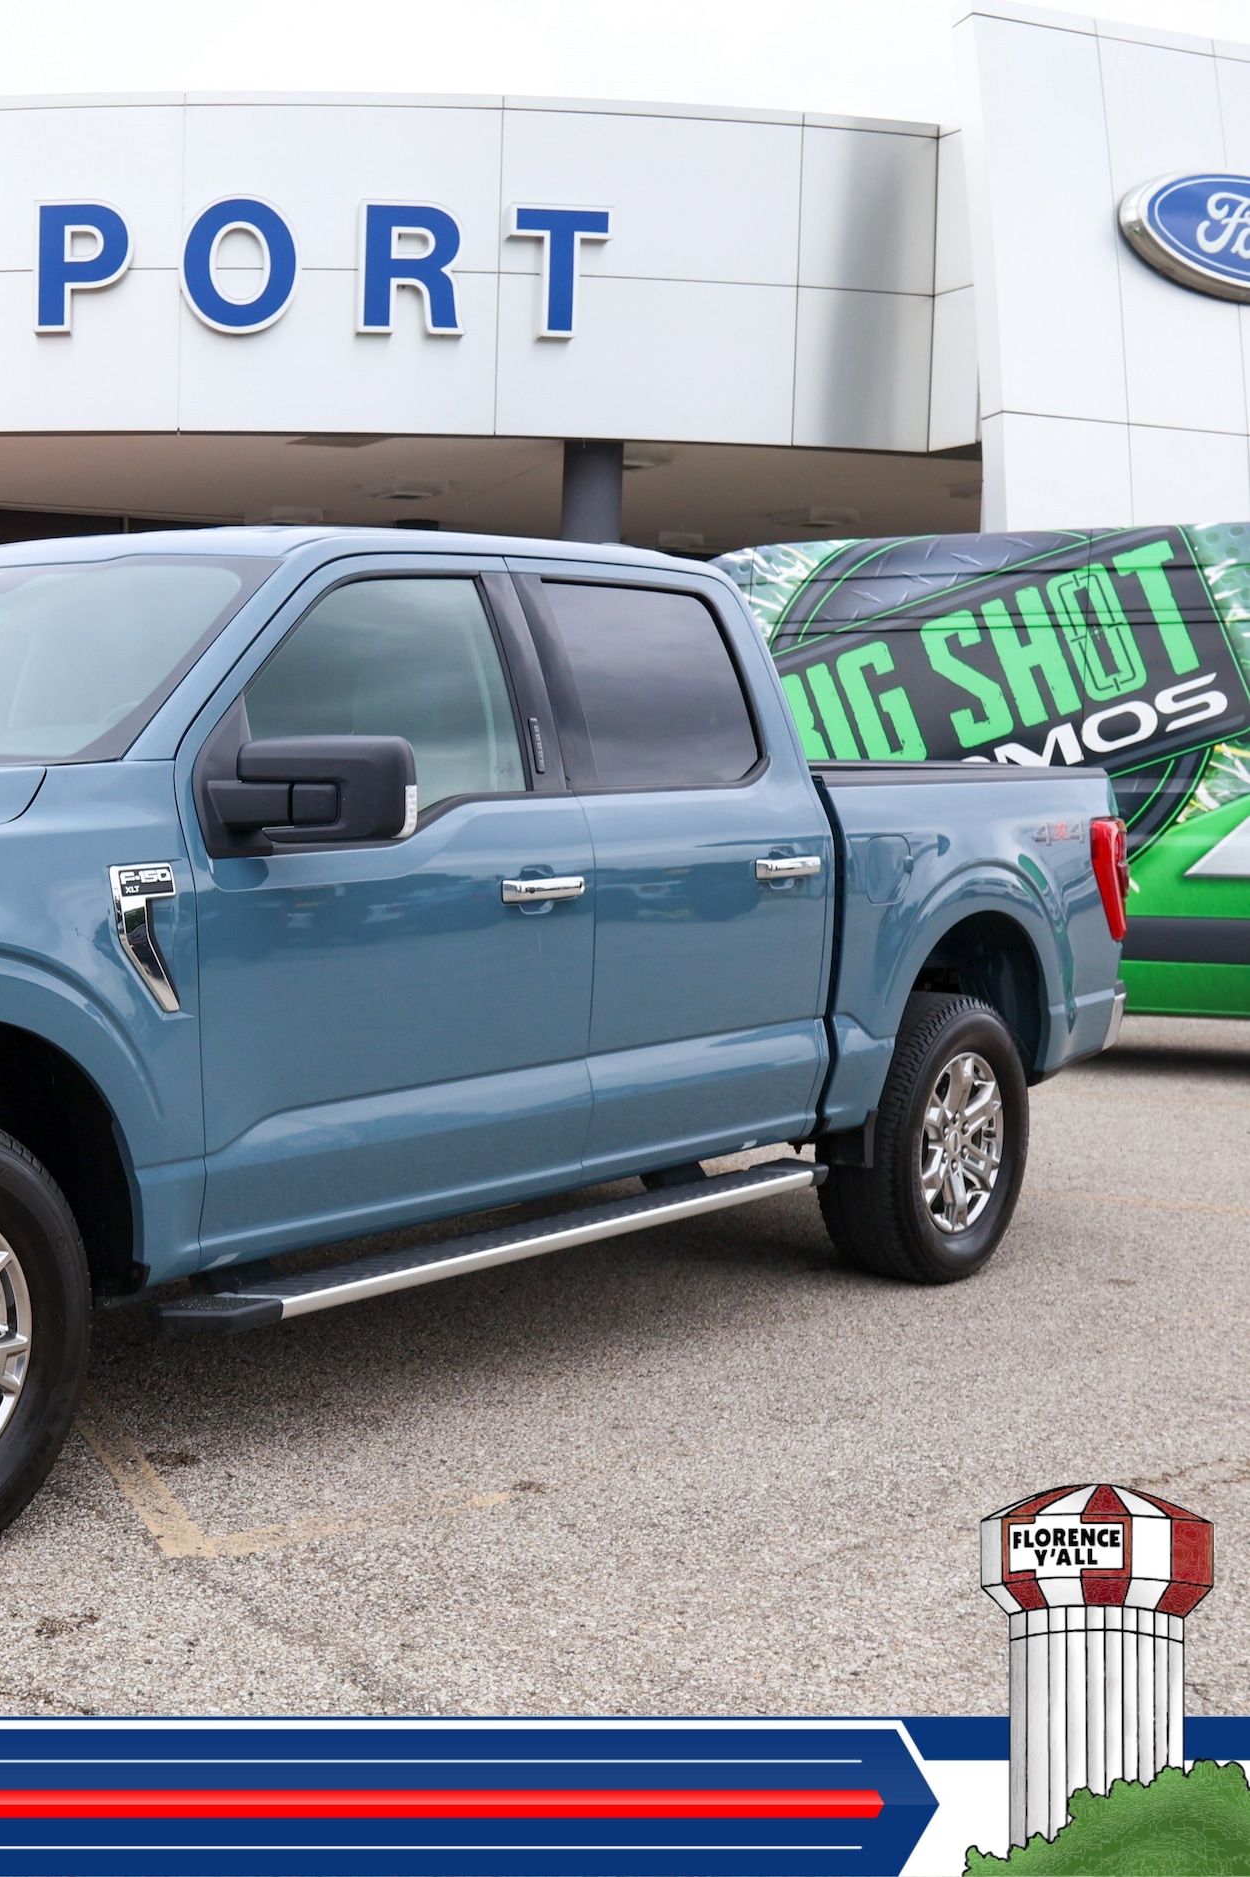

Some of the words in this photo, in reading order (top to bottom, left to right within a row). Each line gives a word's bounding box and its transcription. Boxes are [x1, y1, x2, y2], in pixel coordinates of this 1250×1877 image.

[920, 540, 1201, 748] SHOT
[961, 672, 1228, 766] MOS
[120, 869, 172, 885] F-150
[125, 885, 140, 894] XLT
